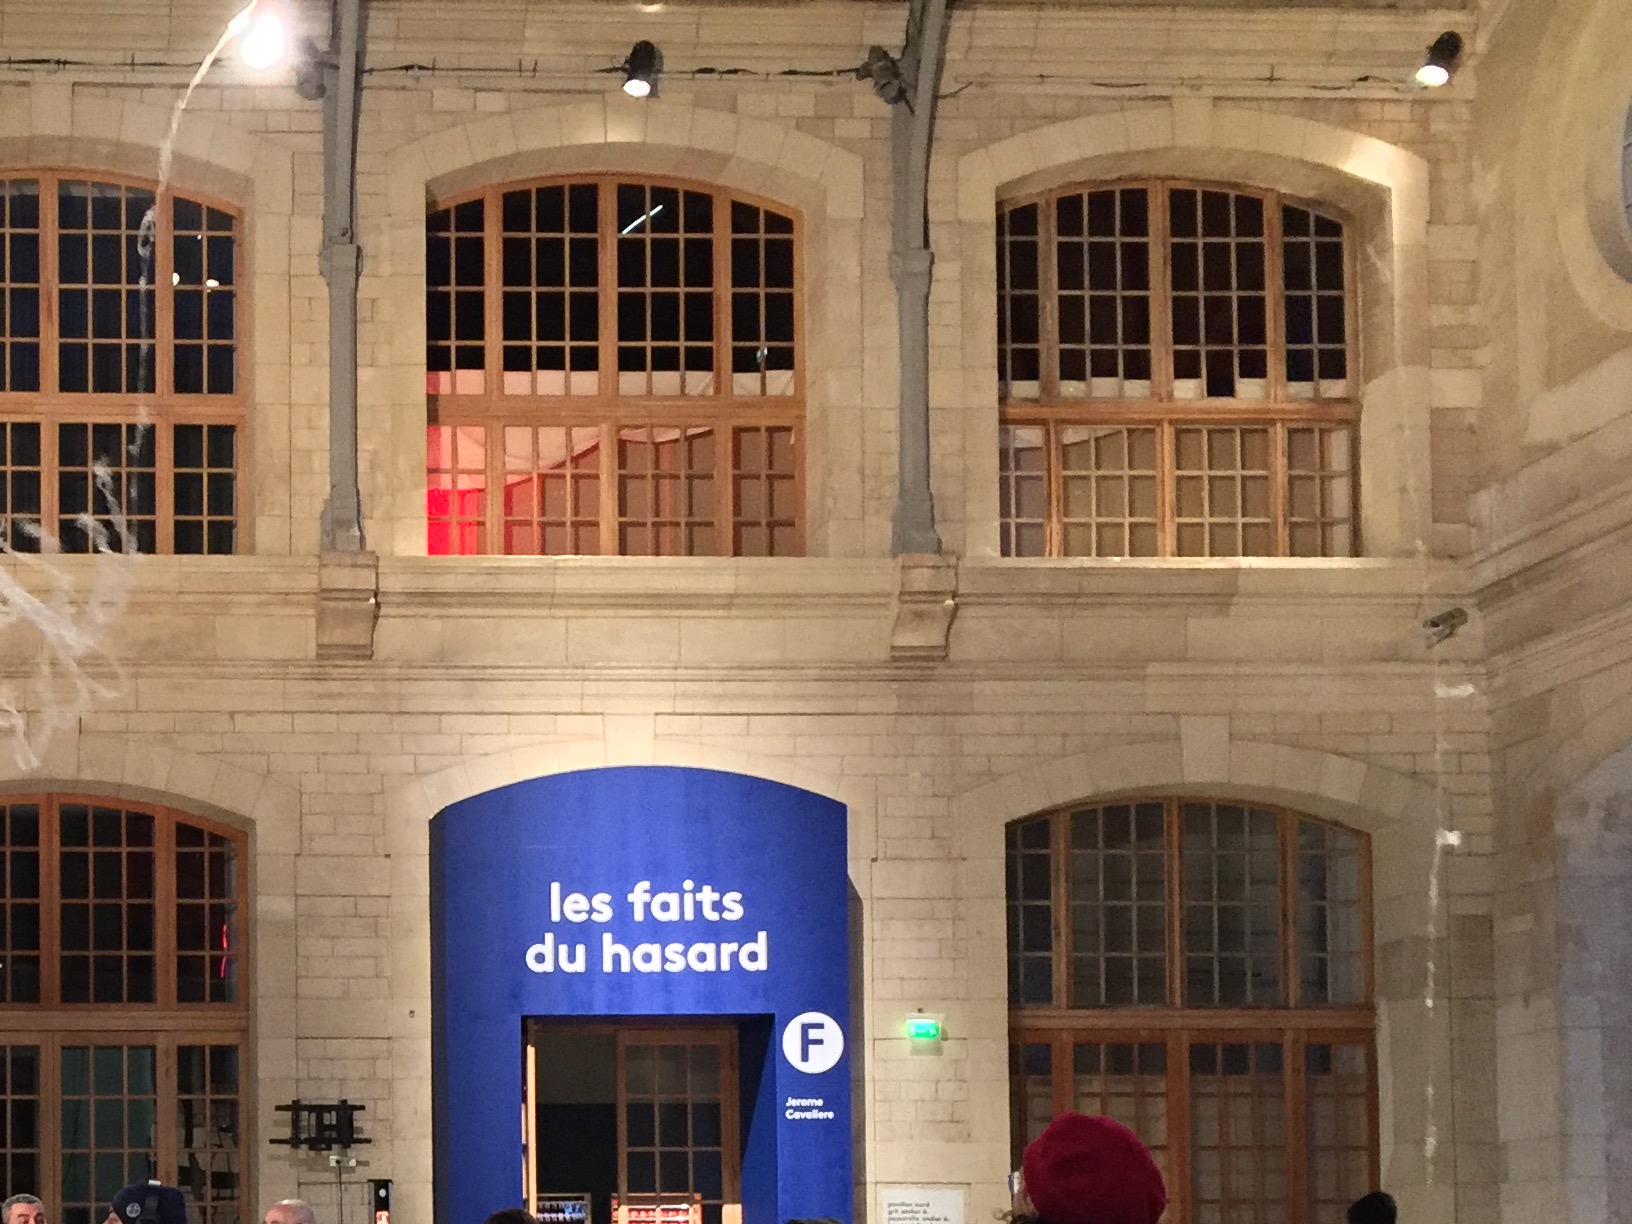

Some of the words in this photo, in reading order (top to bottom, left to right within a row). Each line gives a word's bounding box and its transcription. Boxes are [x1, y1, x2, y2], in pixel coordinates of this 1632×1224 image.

[550, 881, 614, 923] les
[627, 879, 745, 923] faits
[525, 932, 586, 973] du
[602, 930, 768, 973] hasard
[800, 1022, 825, 1063] F
